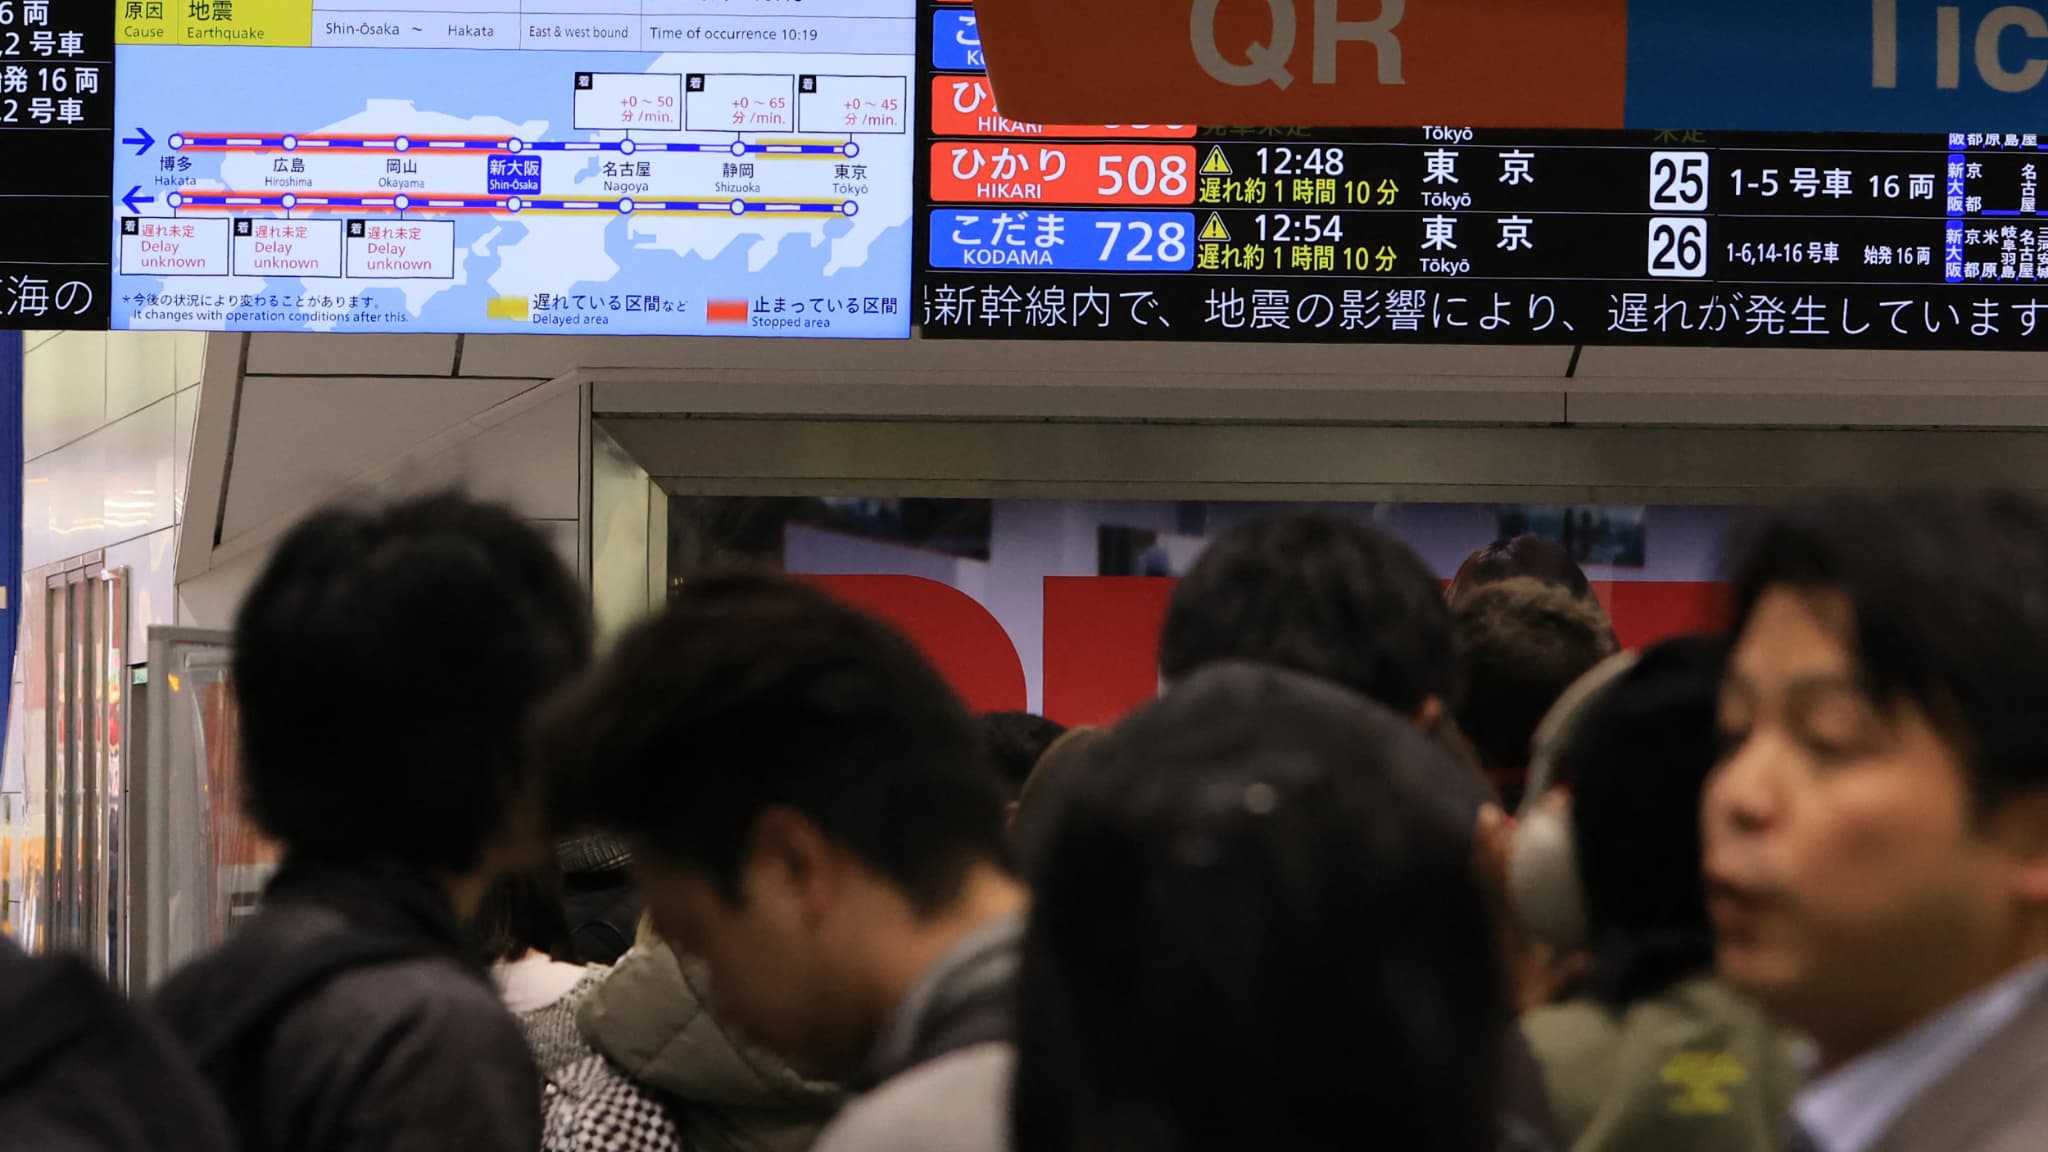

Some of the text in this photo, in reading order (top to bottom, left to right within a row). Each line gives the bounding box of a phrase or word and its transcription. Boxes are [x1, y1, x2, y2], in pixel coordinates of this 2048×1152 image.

[23, 0, 50, 26] 両
[124, 1, 164, 21] 原因
[188, 0, 233, 21] 地震
[124, 26, 164, 39] Cause
[187, 27, 265, 41] Earthquake
[448, 24, 495, 37] Hakata
[529, 26, 628, 39] East & west bound
[650, 26, 818, 41] Time of occurrence 10:19
[29, 30, 85, 57] 号車
[1190, 0, 1405, 91] QR
[0, 65, 99, 94] 発 16 両
[621, 96, 637, 108] +0
[657, 96, 674, 108] 50
[731, 97, 749, 109] +0
[769, 97, 786, 109] 65
[843, 98, 861, 110] +0
[881, 99, 898, 111] 45
[27, 97, 84, 125] 号車
[638, 110, 674, 123] /min.
[750, 112, 786, 125] /min.
[862, 113, 898, 127] /min.
[1422, 125, 1474, 144] Tōkyō
[160, 155, 193, 172] 博多
[273, 157, 306, 173] 広島
[386, 159, 418, 174] 岡山
[489, 159, 540, 177] 新大阪
[602, 161, 651, 177] 名古屋
[951, 146, 1067, 181] ひかり
[1256, 147, 1345, 176] 12:48
[722, 162, 755, 178] 静岡
[834, 164, 868, 179] 東京
[1097, 155, 1188, 197] 508
[155, 175, 197, 187] Hakata
[264, 176, 313, 188] Hiroshima
[378, 178, 425, 190] Okayama
[603, 181, 649, 193] Nagoya
[715, 182, 761, 193] Shizuoka
[1653, 157, 1704, 205] 25
[1730, 167, 1936, 200] 1-5 号車 16 両
[1946, 162, 1965, 212] 新大阪
[976, 183, 1042, 199] HIKARI
[1199, 177, 1400, 206] 遅れ約 1 時間 10 分
[1420, 191, 1472, 210] Tōkyō
[141, 224, 195, 238] 遅れ未定
[255, 225, 308, 239] 遅れ未定
[368, 227, 422, 241] 遅れ未定
[951, 210, 1066, 248] こだま
[1255, 214, 1344, 242] 12:54
[141, 240, 180, 254] Delay
[255, 241, 293, 255] Delay
[368, 243, 406, 256] Delay
[1095, 221, 1187, 263] 728
[1651, 223, 1702, 271] 26
[962, 249, 1053, 265] KODAMA
[1197, 244, 1398, 272] 遅れ約 1 時間 10 分
[1726, 241, 1931, 266] 1-6,14-16 号車 始発 16 両
[1945, 228, 1963, 279] 新大阪
[141, 256, 206, 268] unknown
[254, 257, 319, 269] unknown
[367, 258, 432, 271] unknown
[1419, 257, 1471, 277] Tōkyō
[0, 274, 93, 317] 海の
[753, 296, 898, 315] 止まっている区間
[134, 309, 409, 323] It changes with operation conditions after this.
[532, 313, 609, 326] Delayed area
[752, 315, 830, 328] Stopped area
